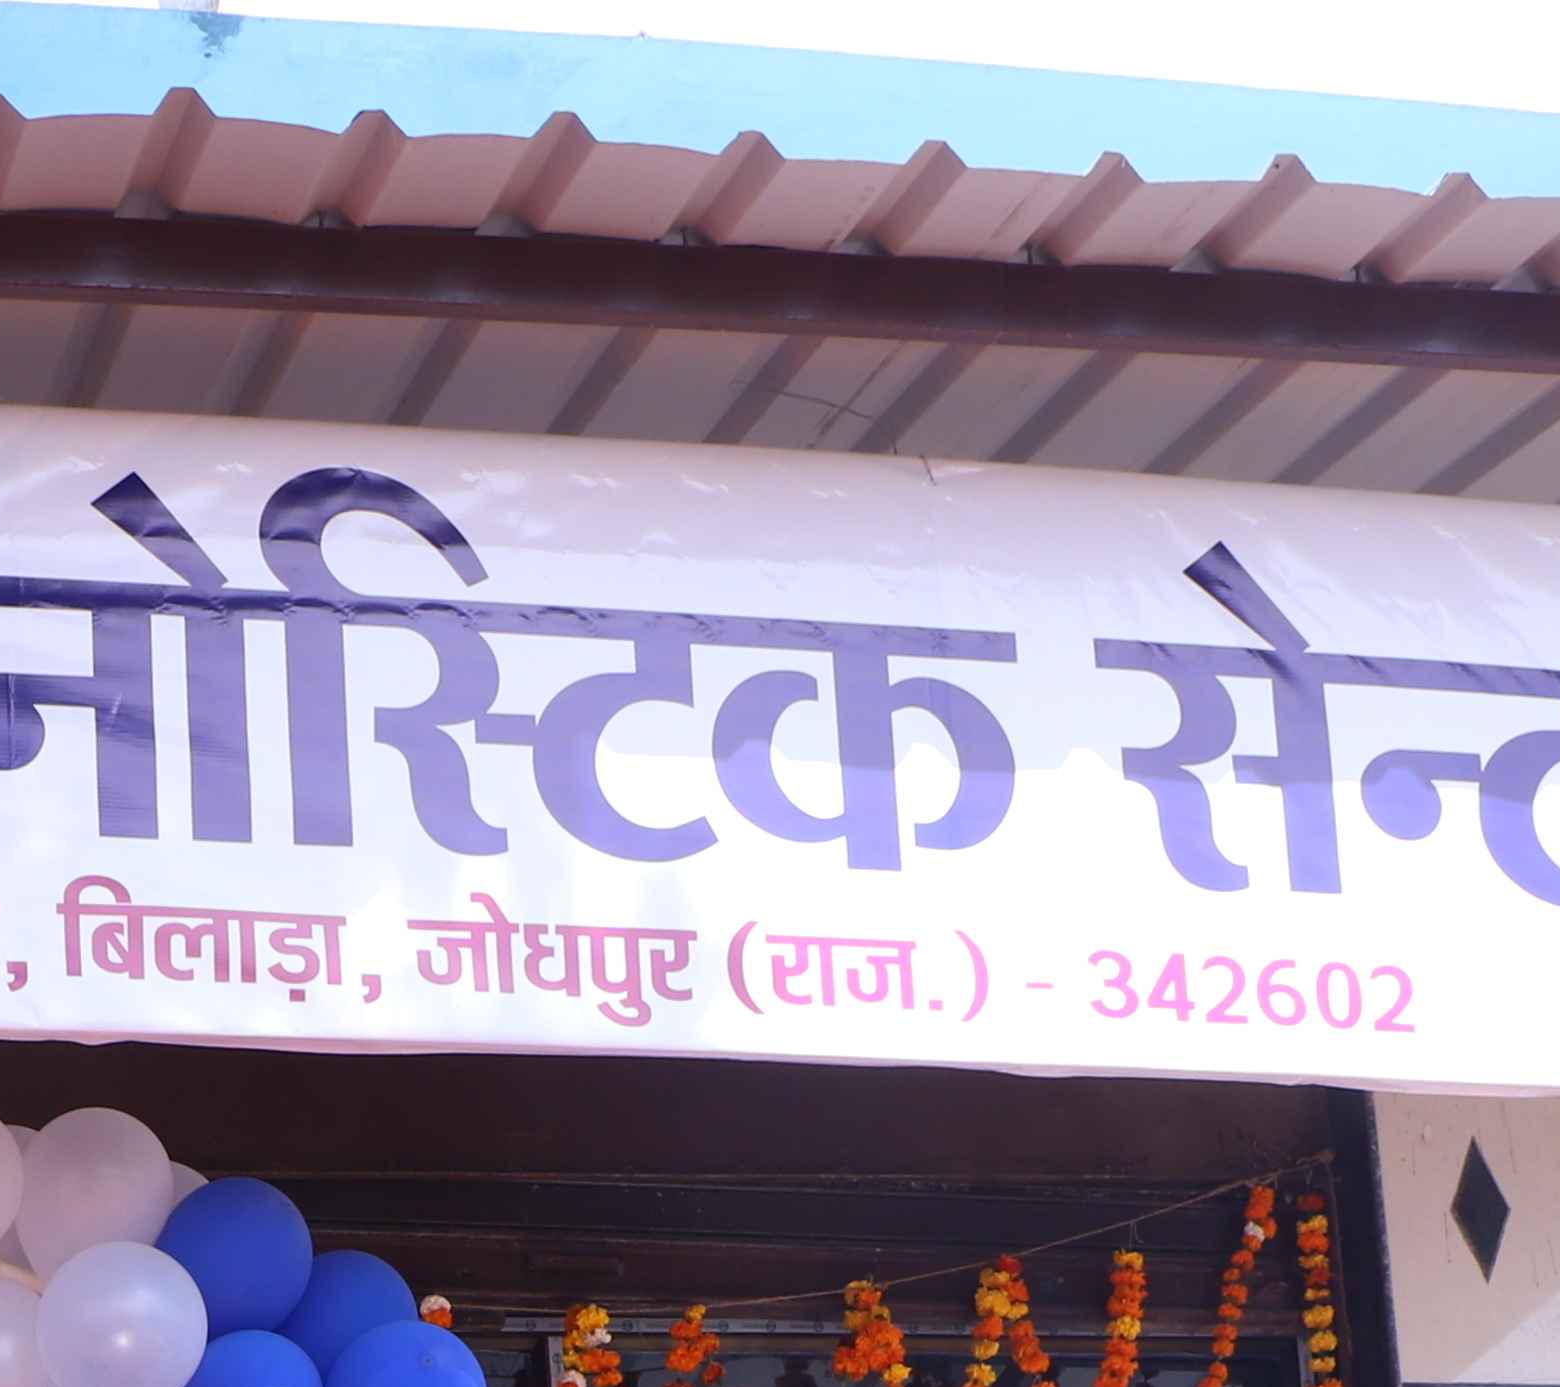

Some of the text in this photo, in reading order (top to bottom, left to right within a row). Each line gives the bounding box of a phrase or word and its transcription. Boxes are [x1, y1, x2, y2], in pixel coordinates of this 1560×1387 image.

[407, 892, 697, 1028] जोधपुर
[726, 921, 989, 1023] (राज.)
[1089, 950, 1418, 1034] 342602
